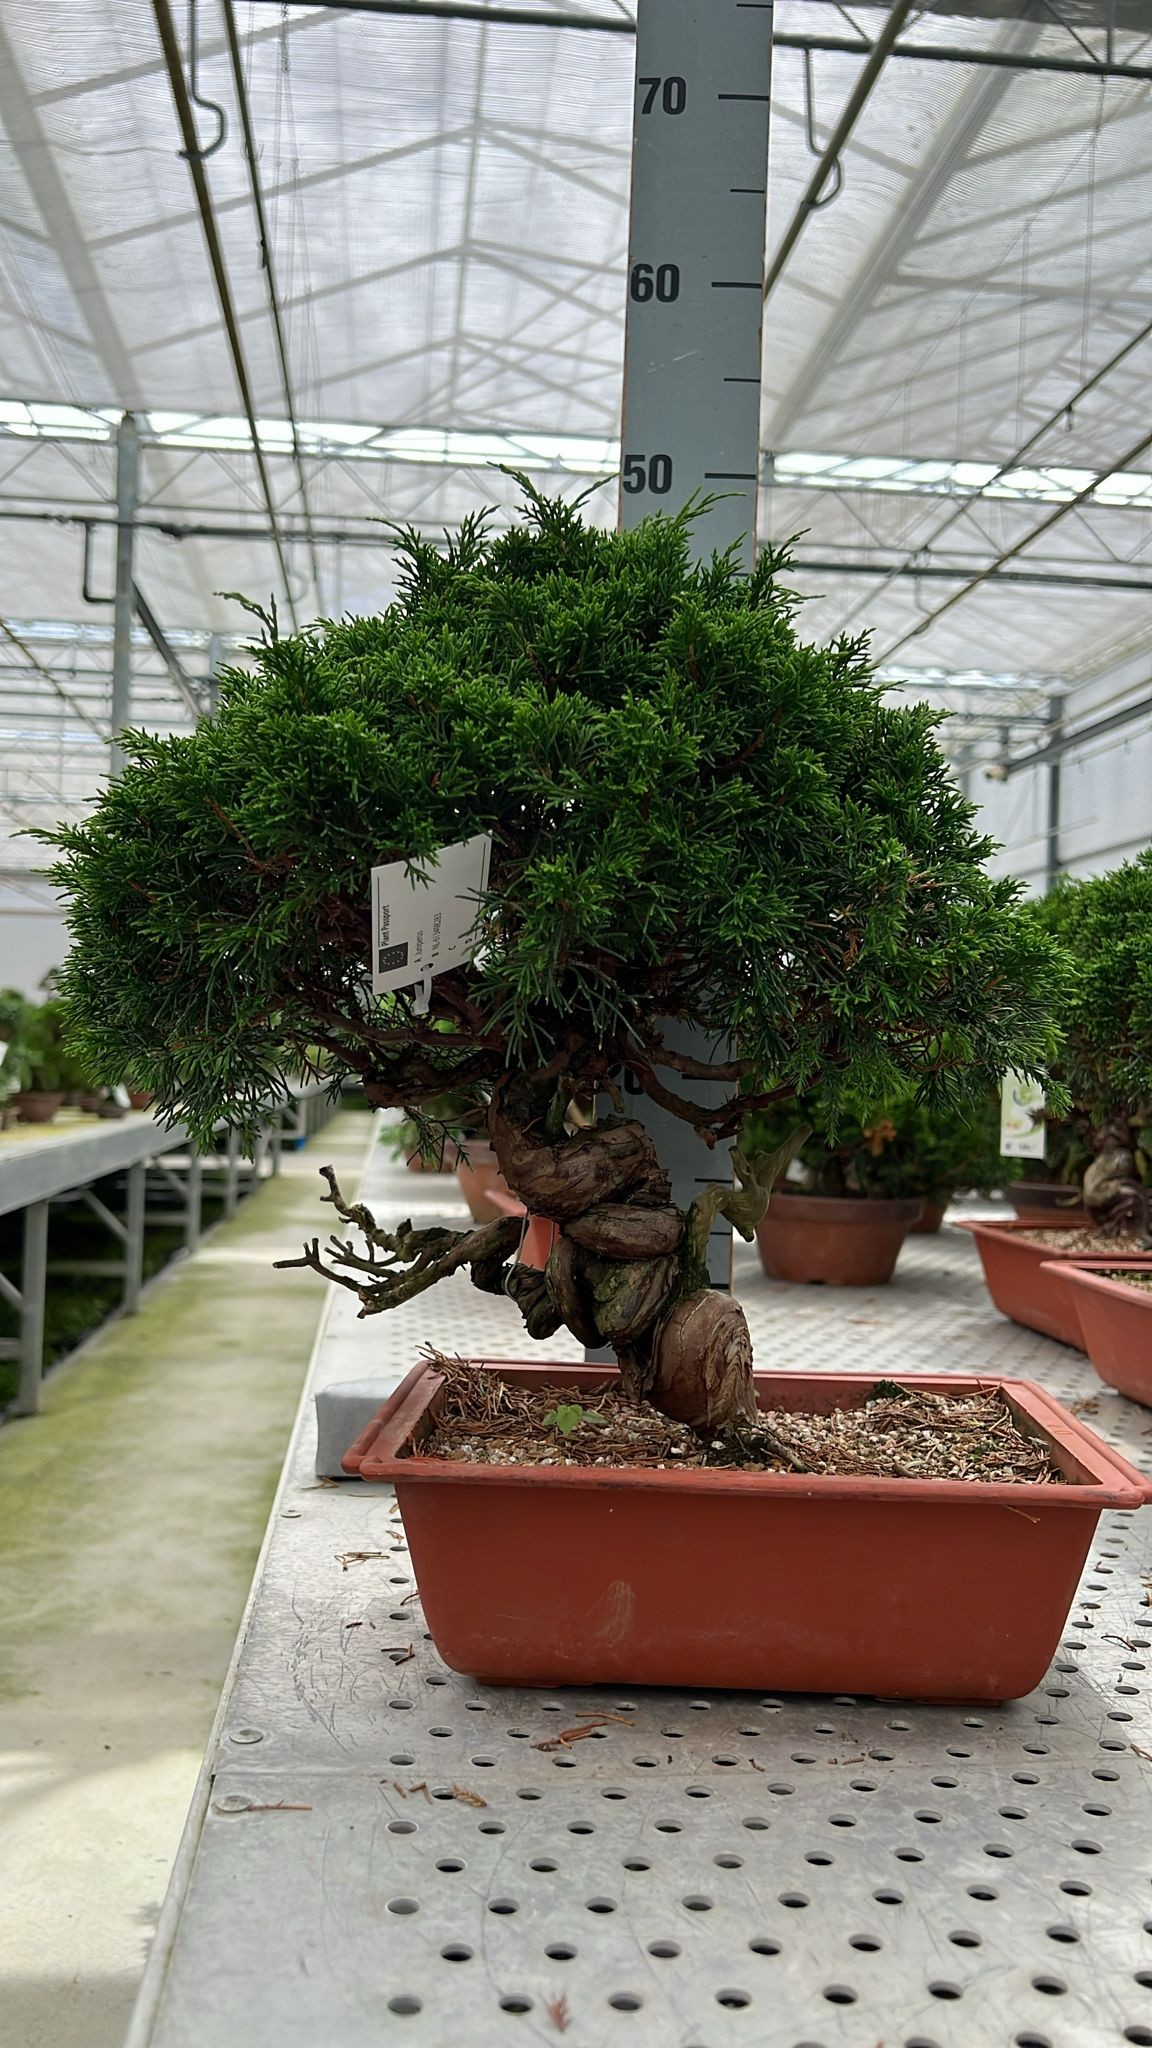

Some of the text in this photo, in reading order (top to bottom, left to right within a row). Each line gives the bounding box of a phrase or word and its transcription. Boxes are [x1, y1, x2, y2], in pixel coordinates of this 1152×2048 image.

[638, 76, 687, 116] 70
[630, 263, 680, 303] 60
[622, 454, 673, 495] 50
[381, 905, 392, 947] Plant Passport
